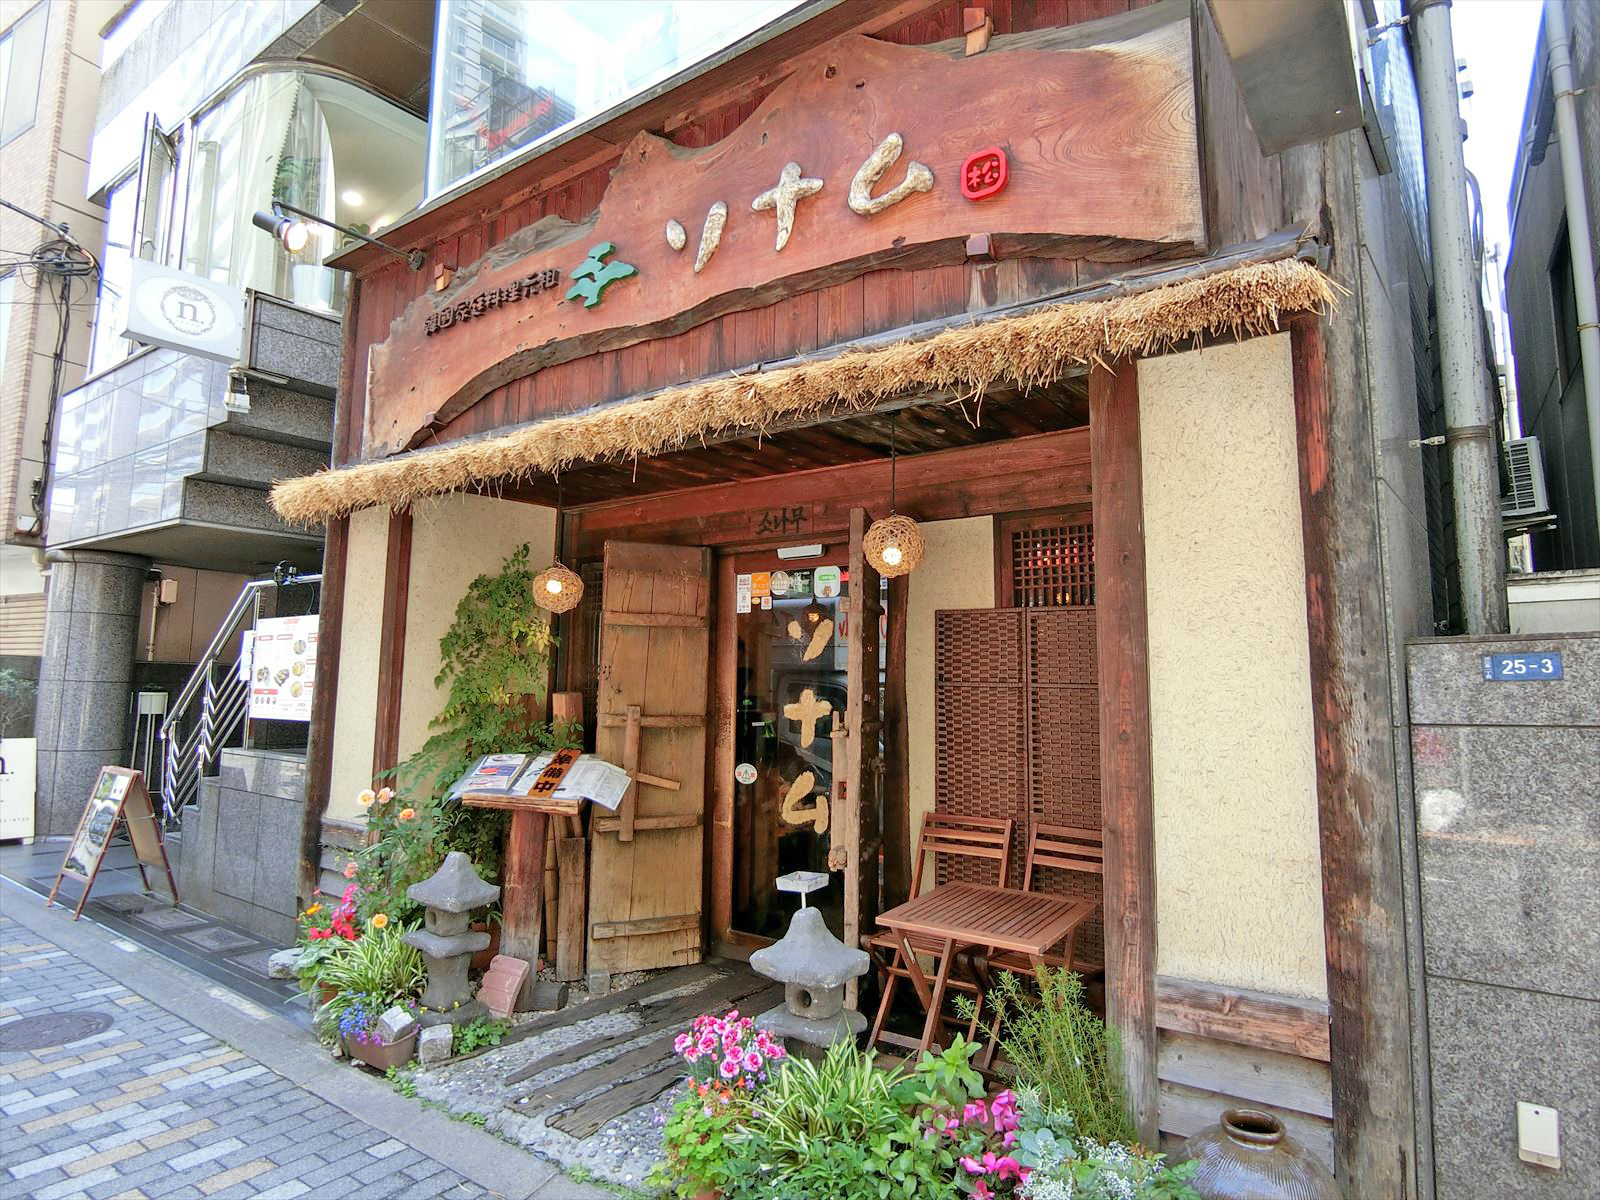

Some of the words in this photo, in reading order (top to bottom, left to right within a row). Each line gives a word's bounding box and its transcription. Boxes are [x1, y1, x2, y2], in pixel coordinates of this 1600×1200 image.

[966, 159, 1000, 188] 松
[755, 506, 808, 535] 소나무
[782, 619, 833, 834] ソナム
